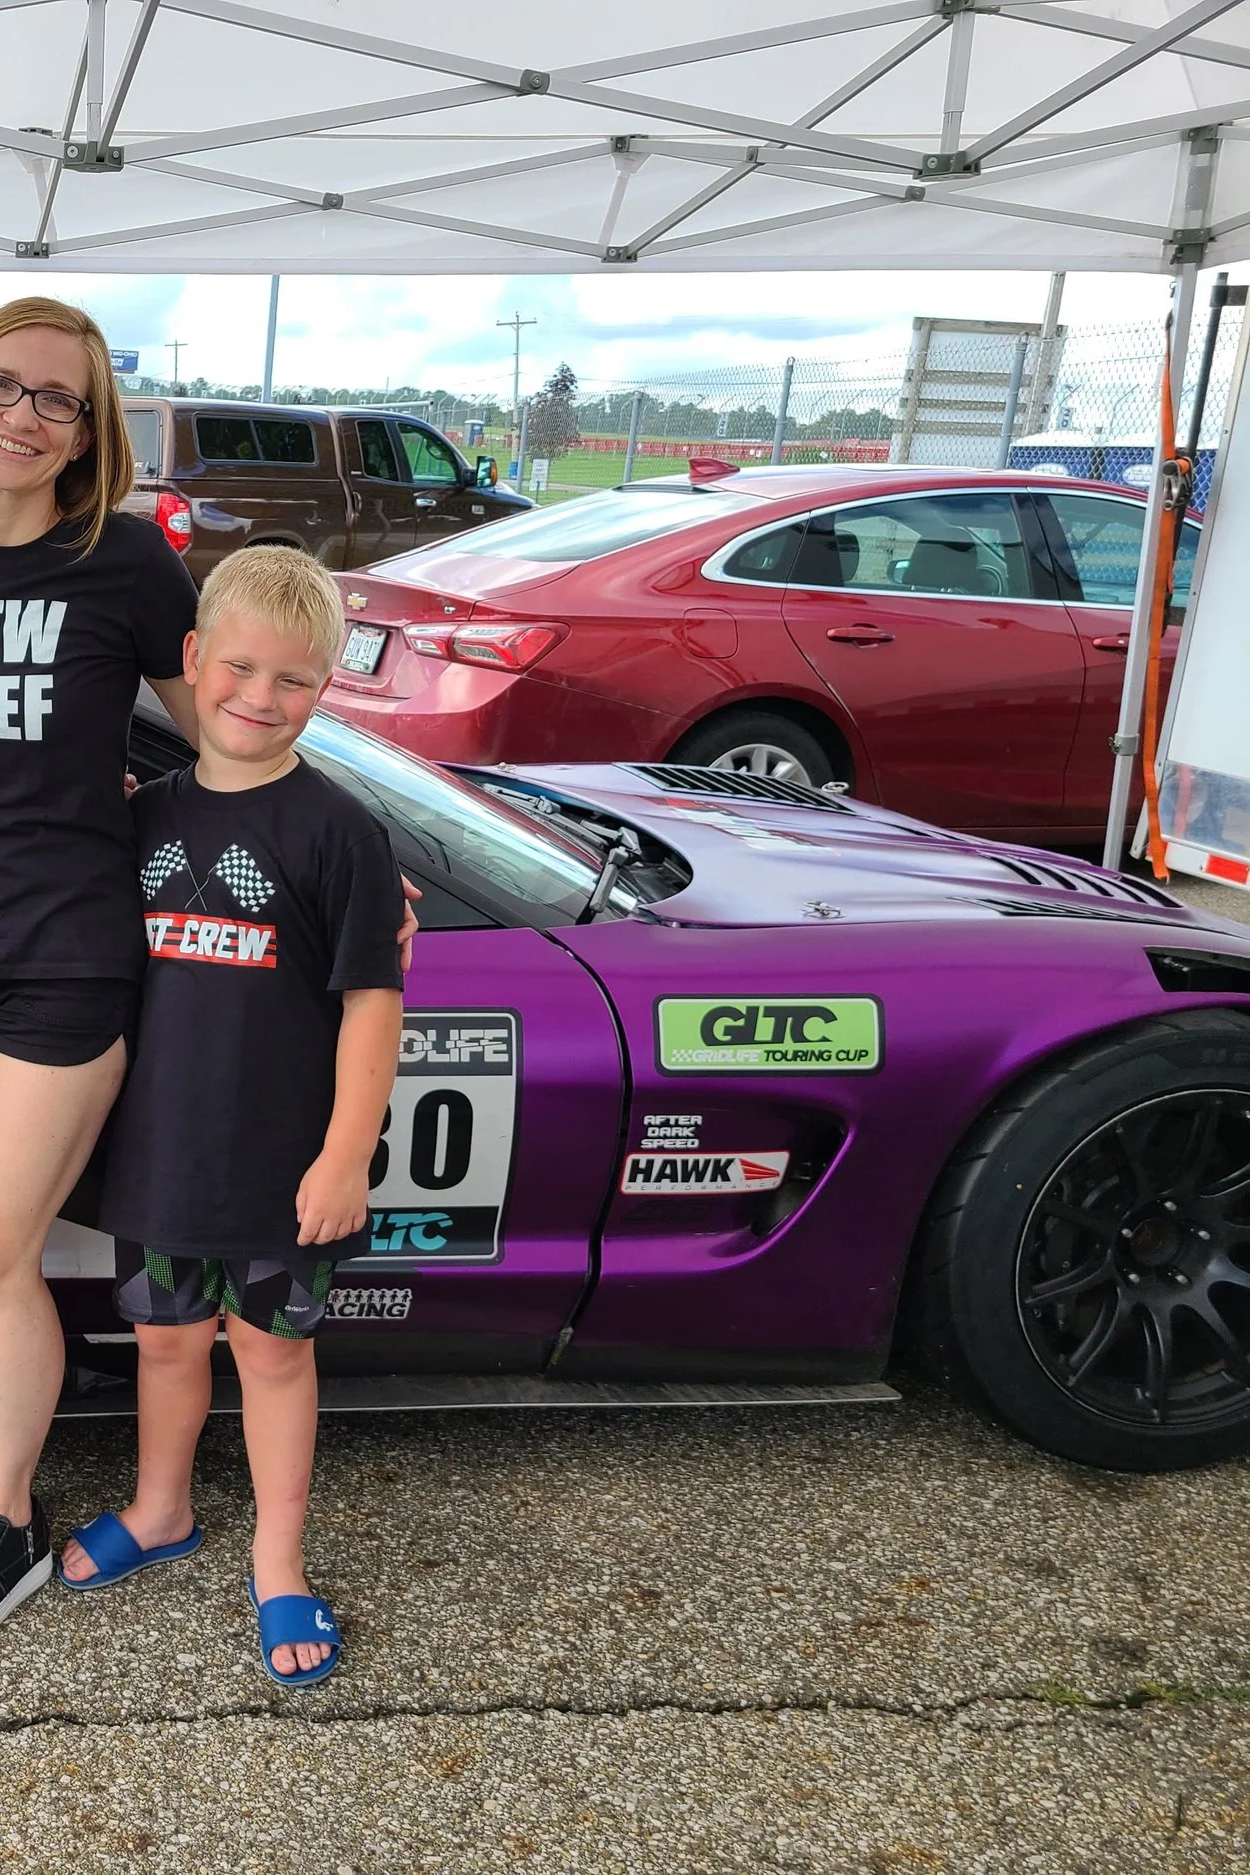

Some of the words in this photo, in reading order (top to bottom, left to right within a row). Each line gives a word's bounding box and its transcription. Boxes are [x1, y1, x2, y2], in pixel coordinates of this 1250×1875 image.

[180, 920, 272, 961] CREW
[700, 1005, 838, 1047] GLTC
[692, 1049, 760, 1063] GRIDLIFE
[764, 1048, 832, 1062] TOURING
[835, 1048, 869, 1062] CUP
[643, 1115, 703, 1126] AFTER
[647, 1126, 695, 1137] DARK
[640, 1138, 700, 1149] SPEED
[628, 1157, 736, 1184] HAWK
[625, 1180, 779, 1192] PERFORMANCE
